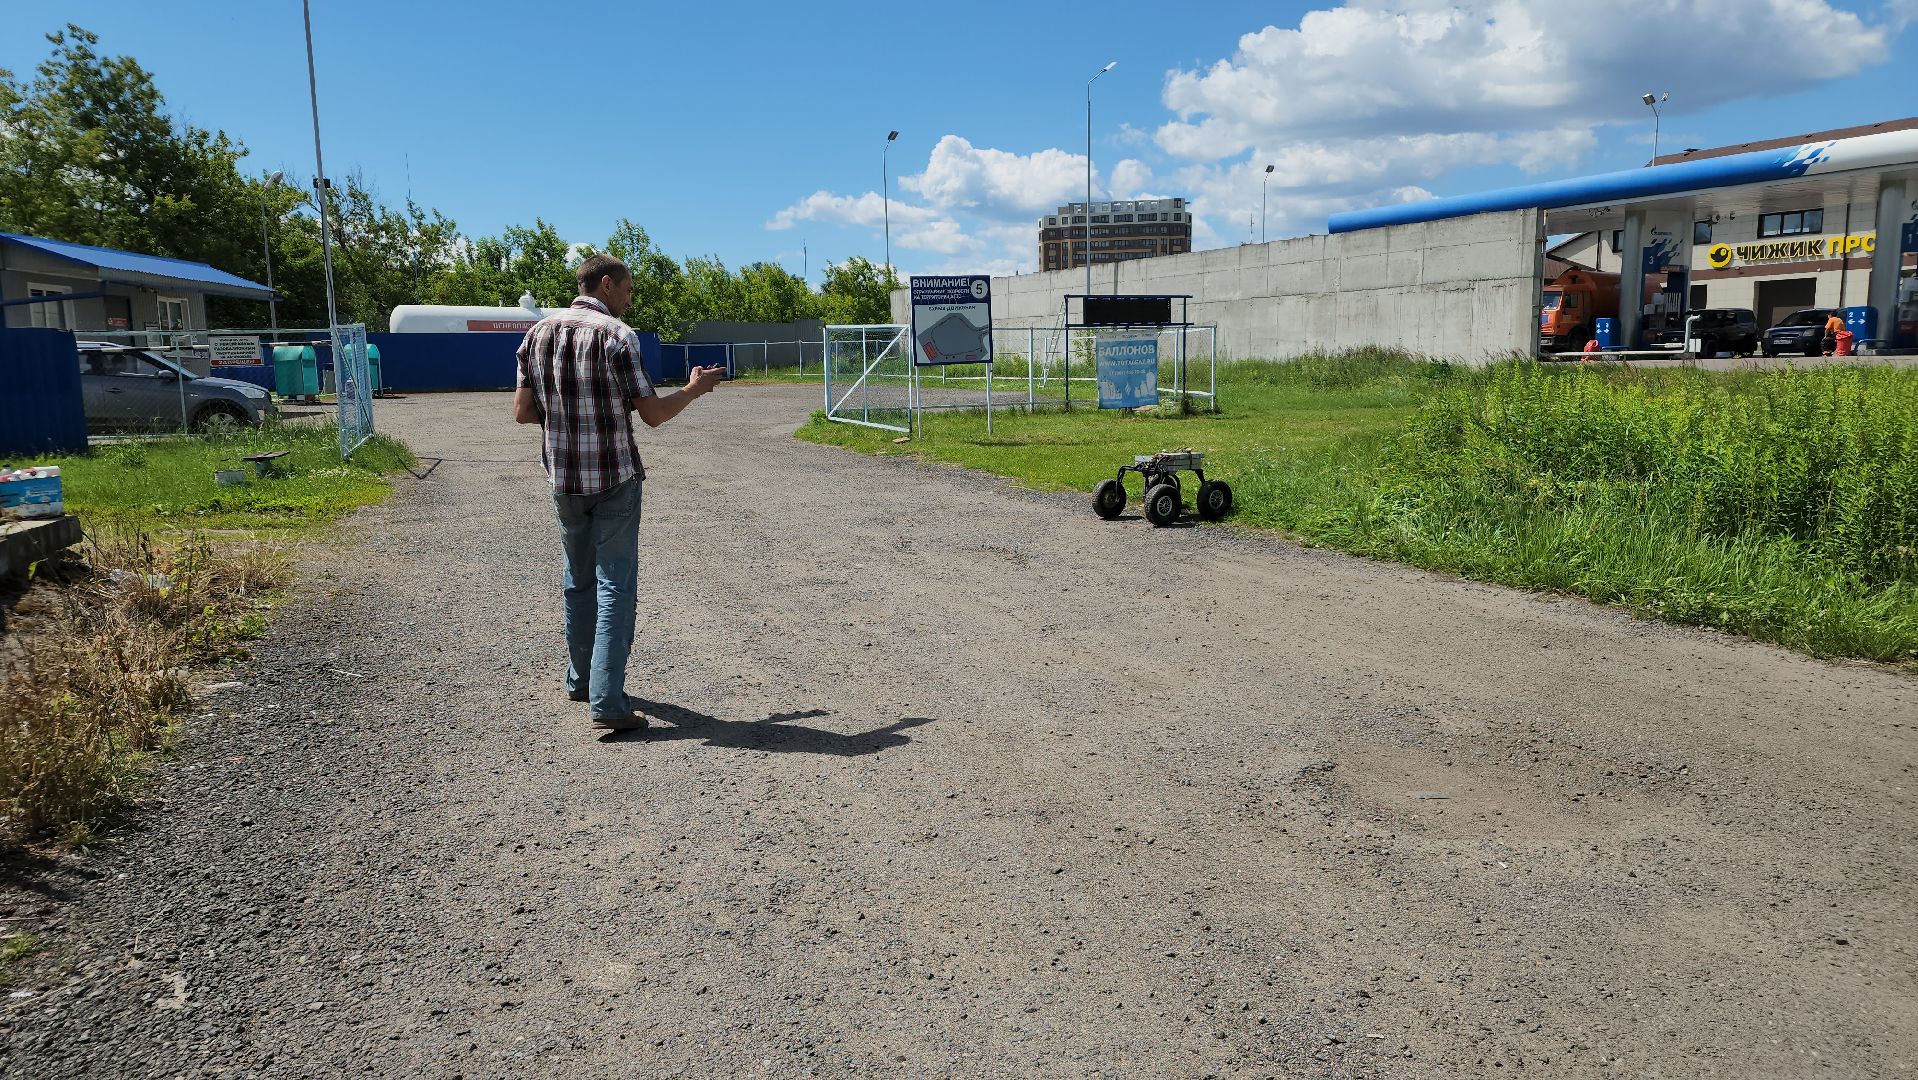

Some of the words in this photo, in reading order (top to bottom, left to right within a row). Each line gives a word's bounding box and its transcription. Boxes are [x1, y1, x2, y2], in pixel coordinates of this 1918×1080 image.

[1736, 238, 1825, 262] ЧИЖИК
[1648, 255, 1654, 265] 3
[912, 278, 970, 288] ВНИМАНИЕ!
[976, 283, 983, 295] 5
[1098, 344, 1155, 357] БАЛЛОНОВ
